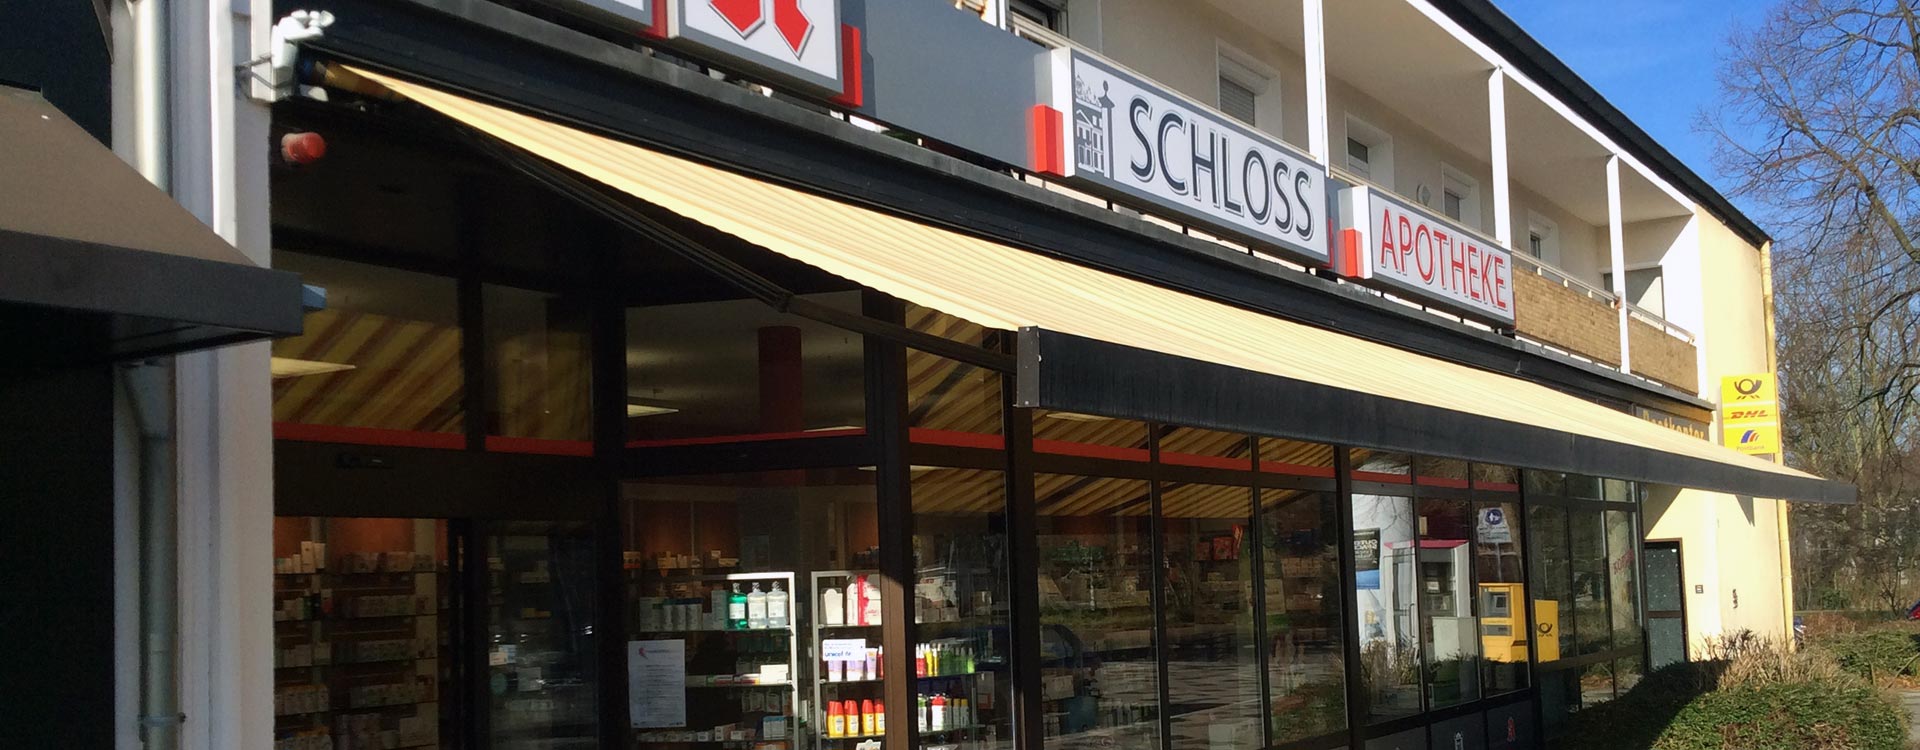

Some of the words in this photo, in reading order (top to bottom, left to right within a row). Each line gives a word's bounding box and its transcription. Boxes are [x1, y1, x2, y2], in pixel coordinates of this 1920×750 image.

[1129, 95, 1314, 243] SCHLOSS
[1379, 207, 1508, 311] APOTHEKE
[1731, 410, 1768, 419] DHL
